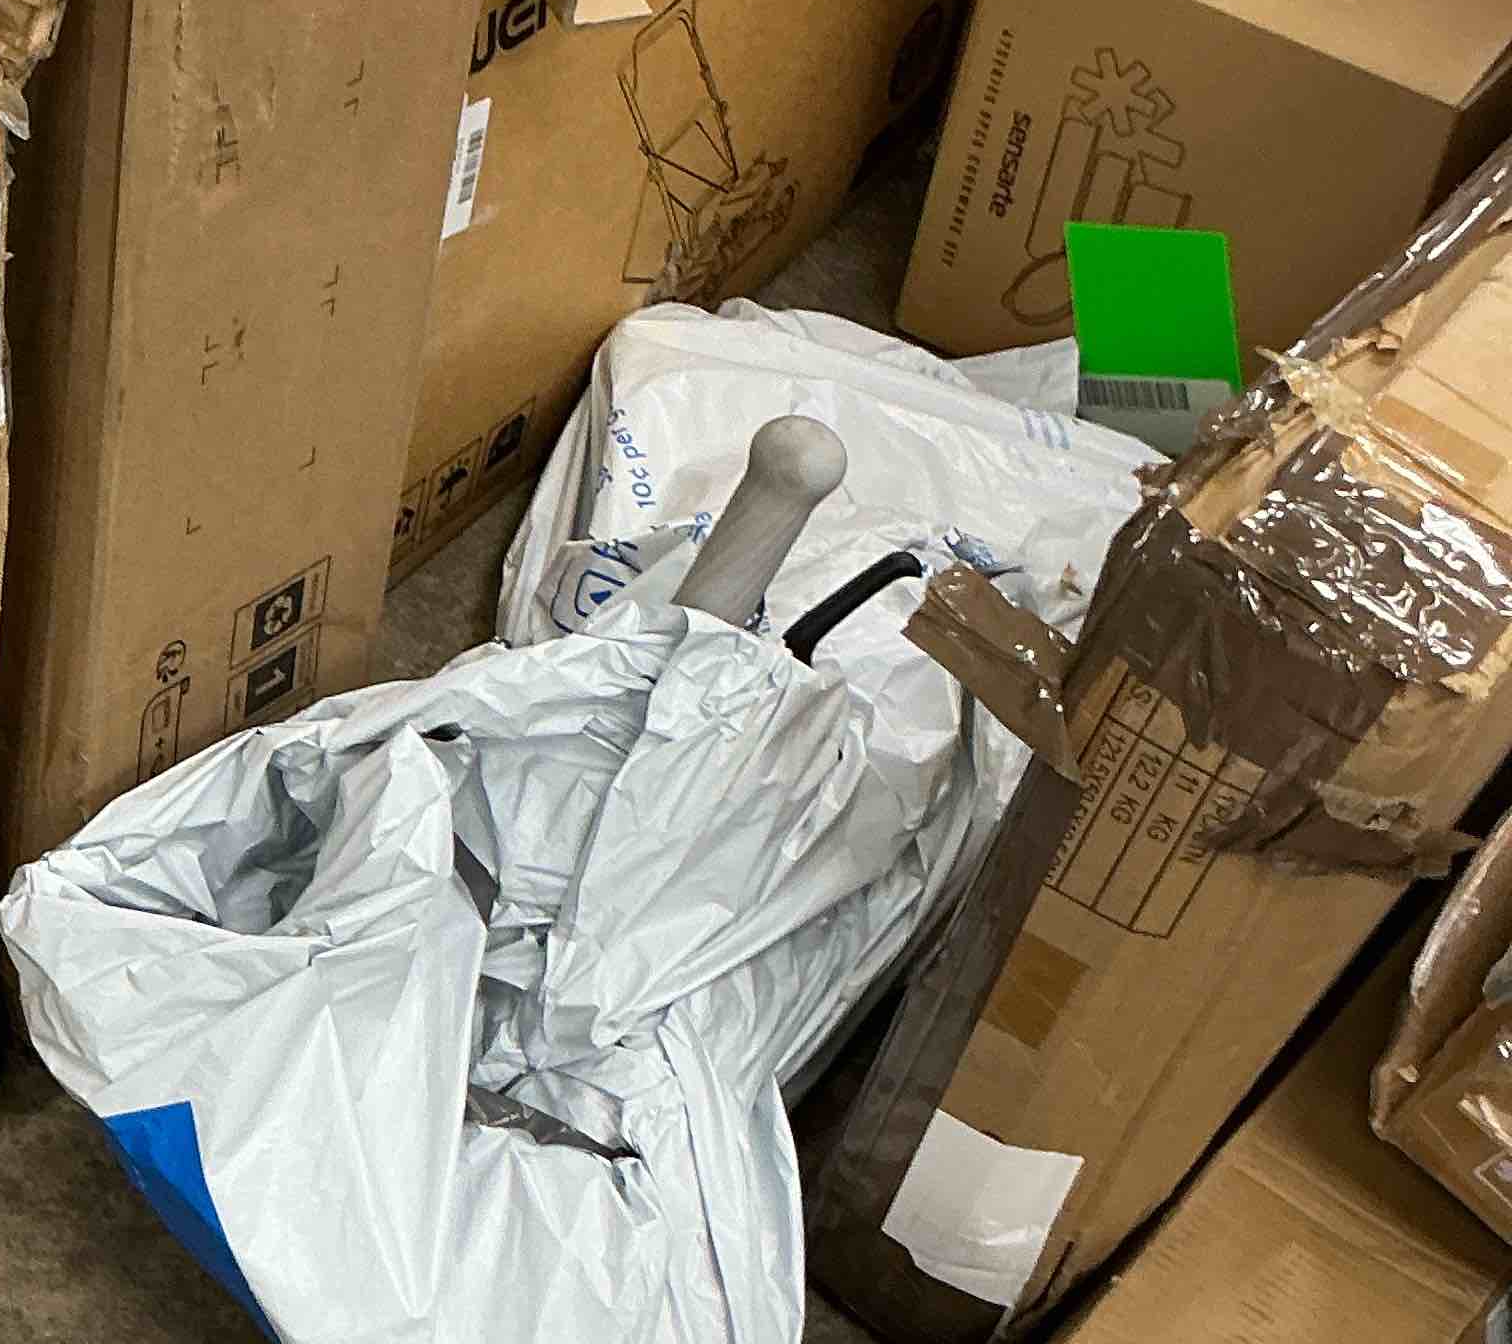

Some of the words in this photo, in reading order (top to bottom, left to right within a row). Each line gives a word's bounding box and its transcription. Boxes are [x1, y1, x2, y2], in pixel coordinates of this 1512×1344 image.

[990, 109, 1033, 219] sensarte
[1109, 791, 1143, 826] KG
[1147, 811, 1180, 844] KG
